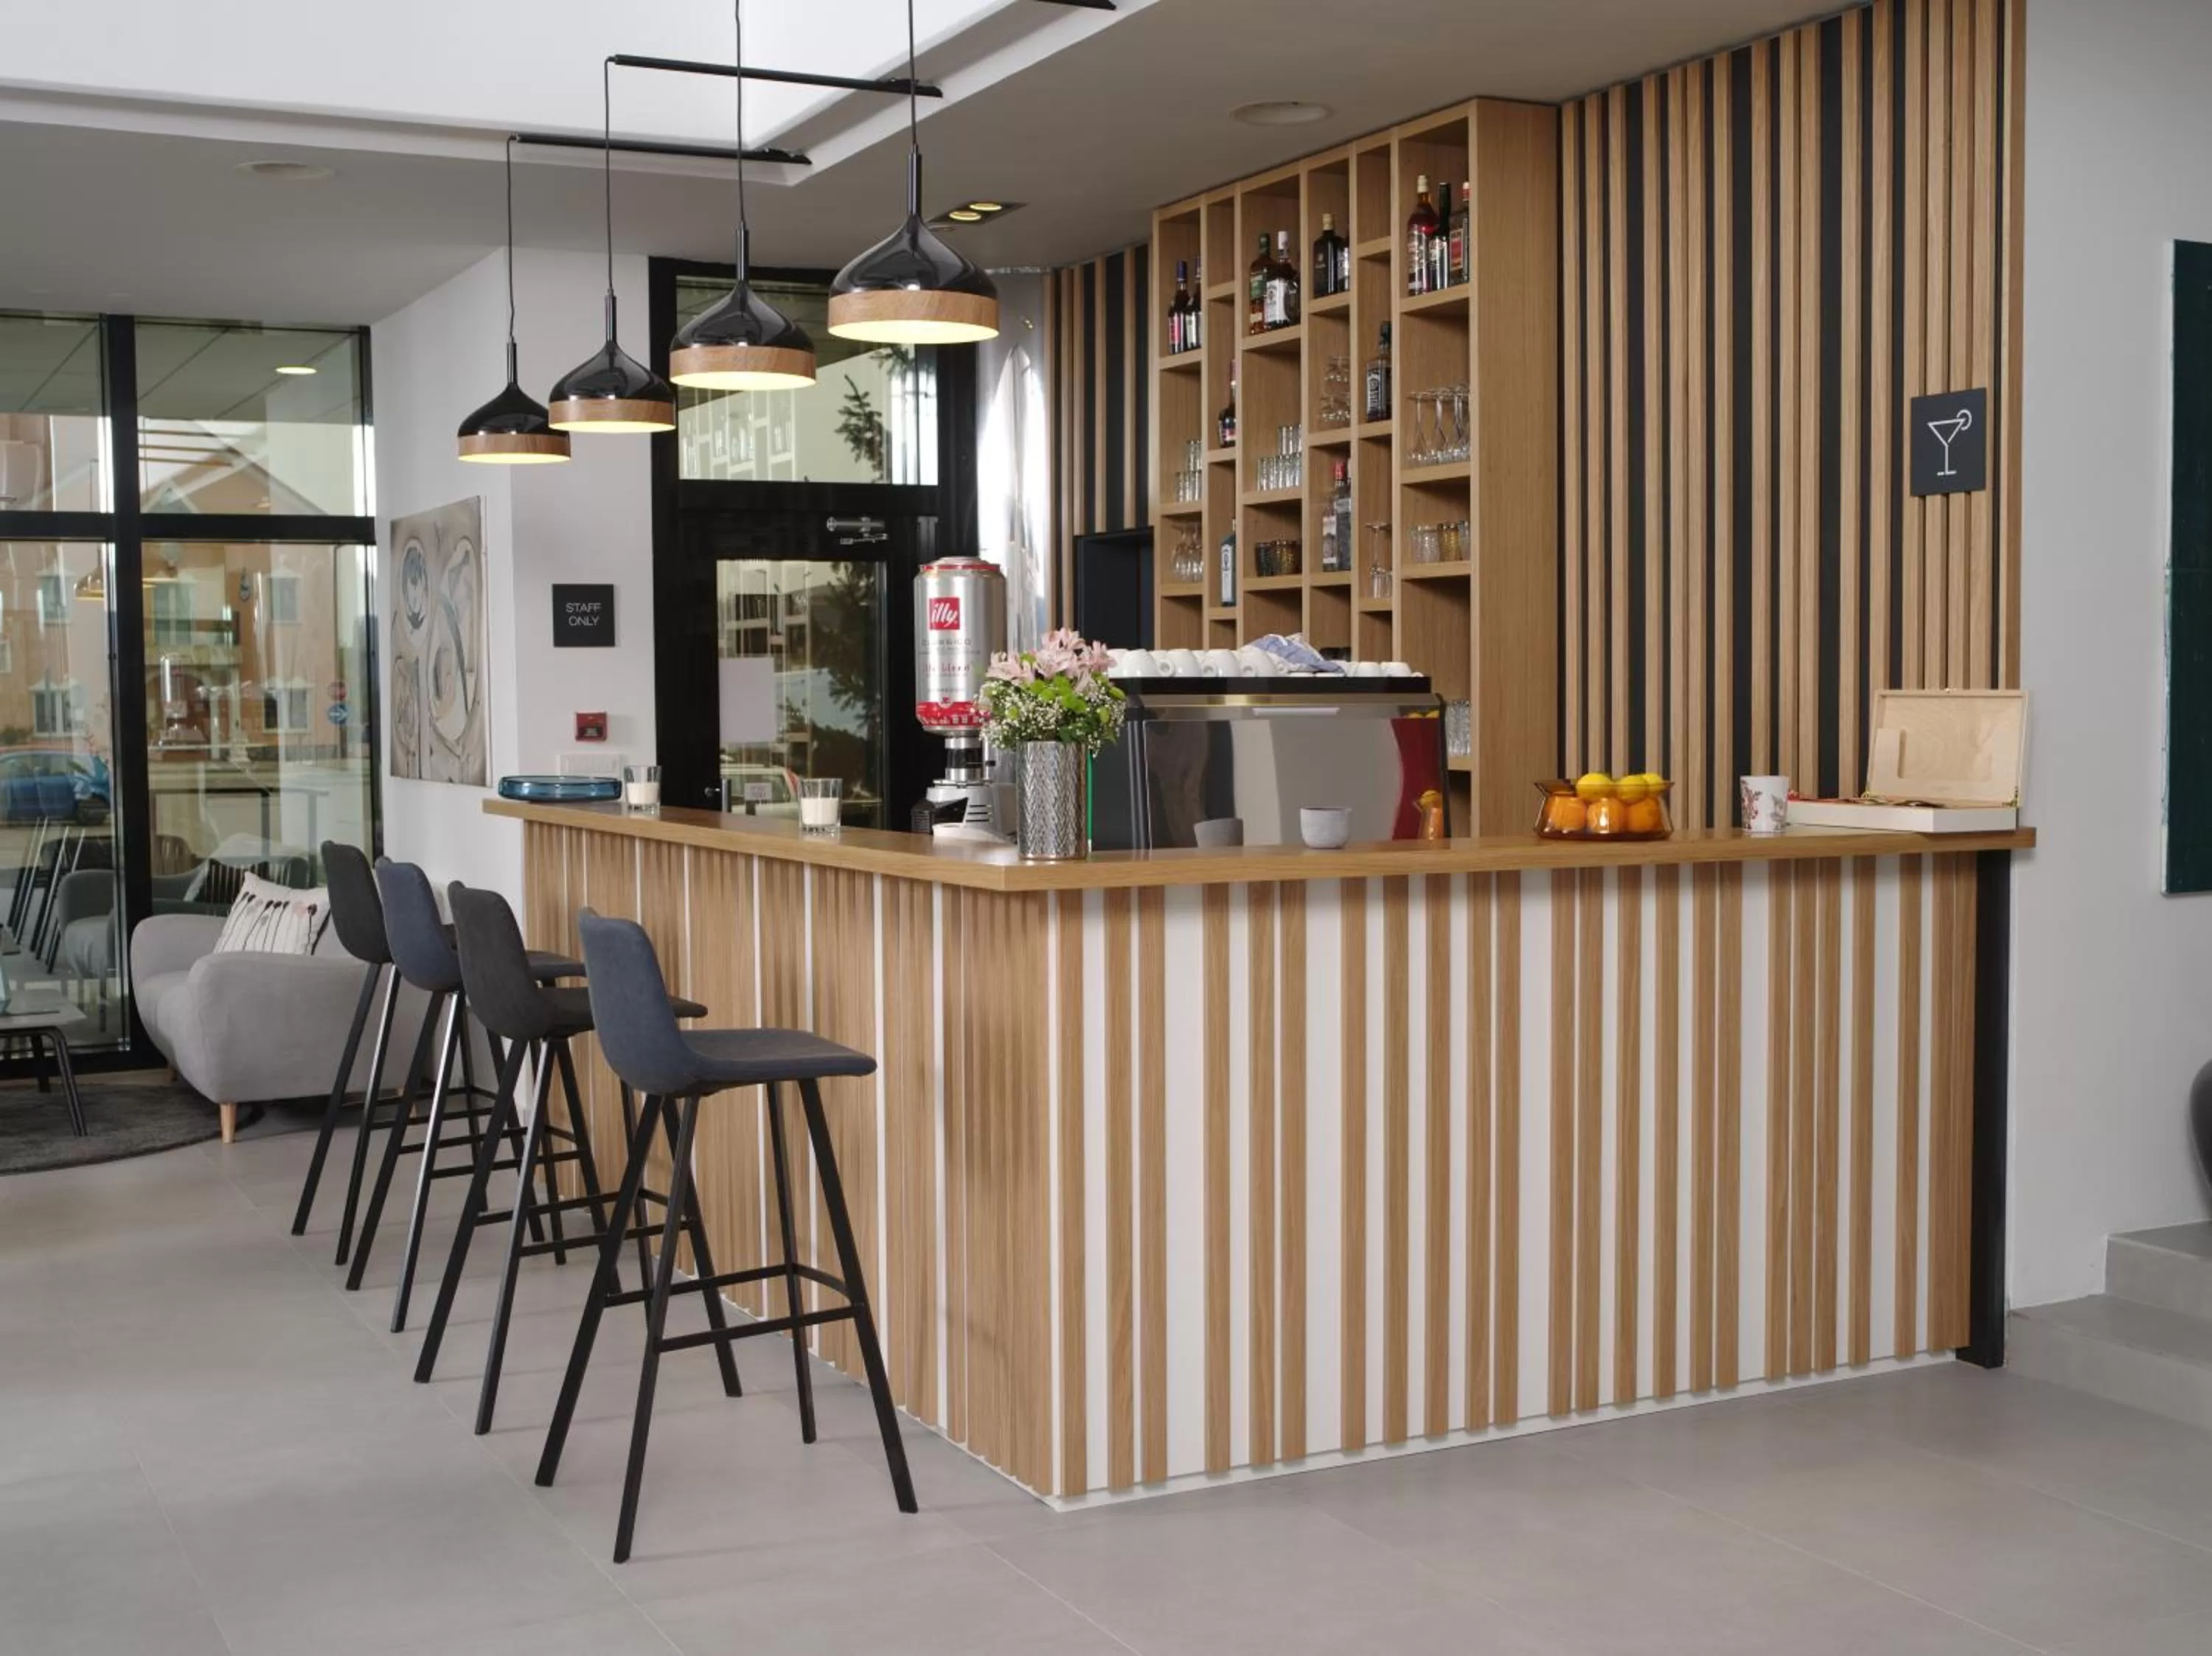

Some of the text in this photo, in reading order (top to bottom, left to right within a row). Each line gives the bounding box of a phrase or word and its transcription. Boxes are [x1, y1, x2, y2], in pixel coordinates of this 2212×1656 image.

[566, 602, 602, 613] STAFF
[931, 602, 958, 627] illy
[568, 616, 599, 626] ONLY
